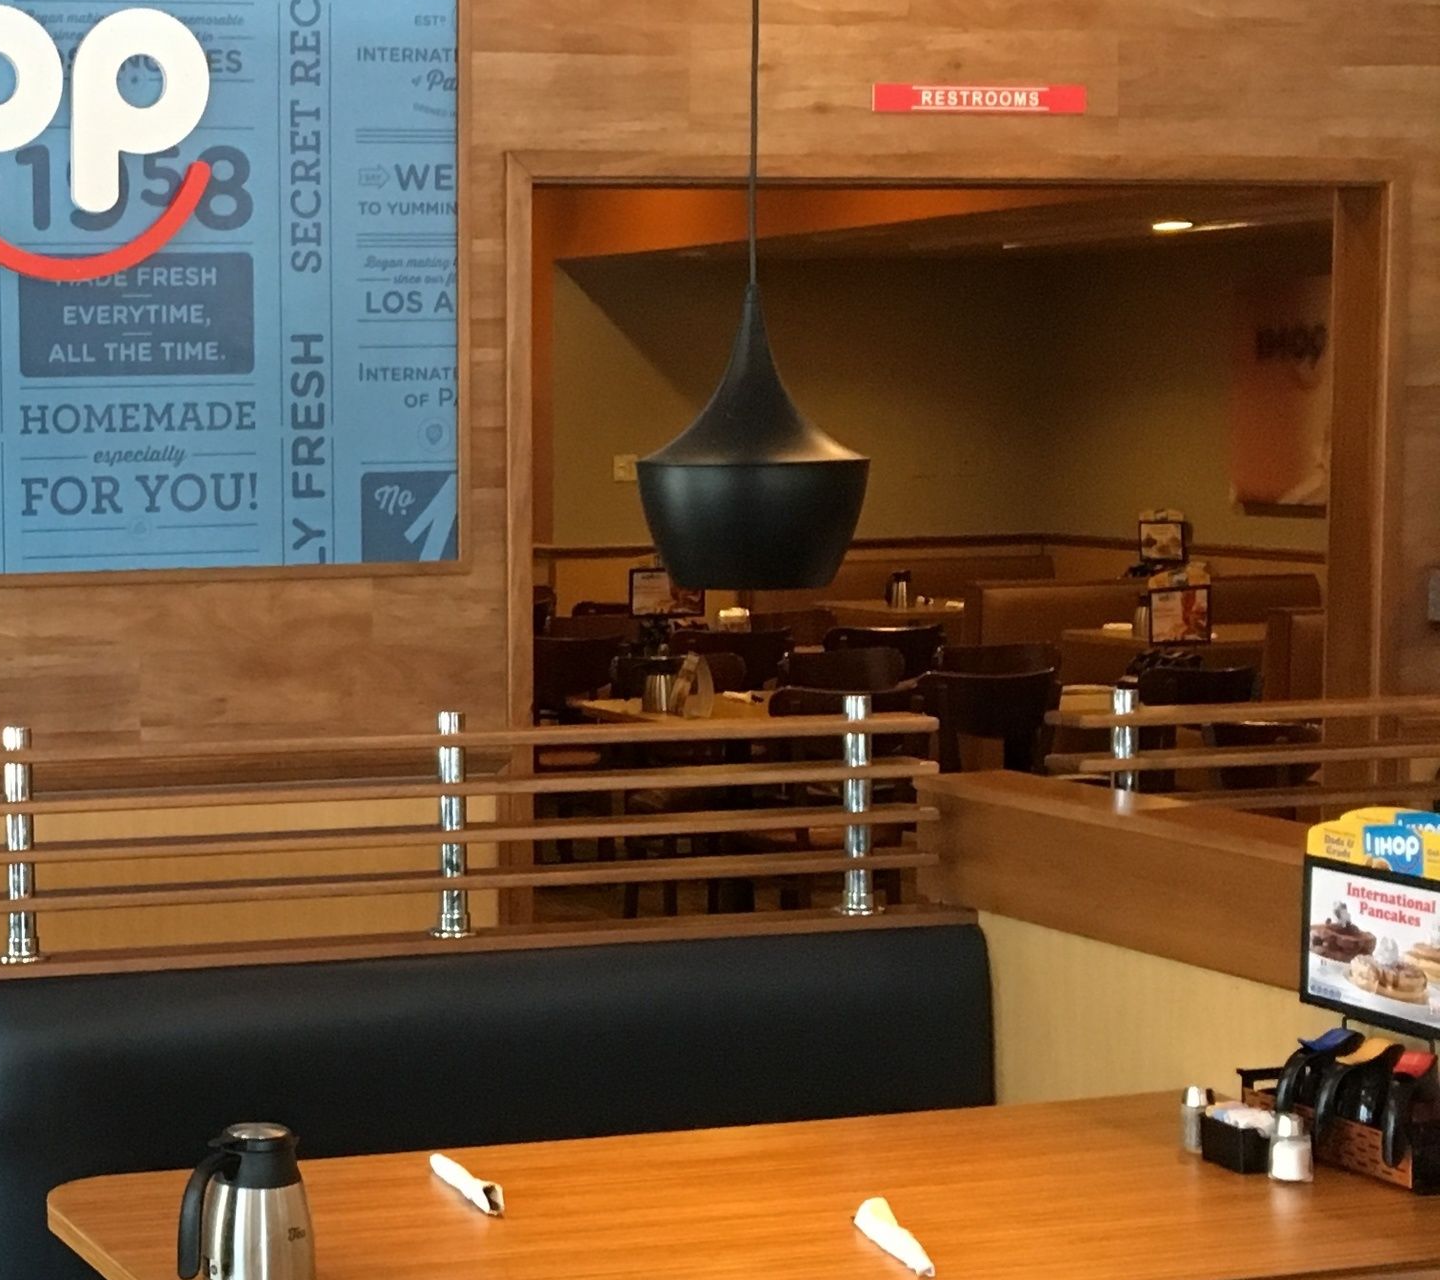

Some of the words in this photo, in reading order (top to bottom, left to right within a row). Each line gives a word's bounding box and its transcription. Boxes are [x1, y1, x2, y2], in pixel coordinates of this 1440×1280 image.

[921, 90, 1040, 107] RESTROOMS
[290, 100, 322, 273] SECRET
[358, 201, 382, 215] TO
[137, 267, 217, 286] FRESH
[63, 304, 210, 326] EVERYTIME,
[366, 291, 422, 314] LOS
[49, 344, 95, 362] ALL
[104, 342, 152, 361] THE
[161, 342, 226, 360] TIME.
[20, 401, 256, 435] HOMEMADE
[291, 334, 325, 498] FRESH
[93, 445, 187, 467] especially
[21, 476, 123, 516] FOR
[135, 473, 258, 512] YOU!
[1374, 835, 1420, 862] IHOP
[1346, 882, 1437, 914] International
[1359, 900, 1421, 928] Pancakes
